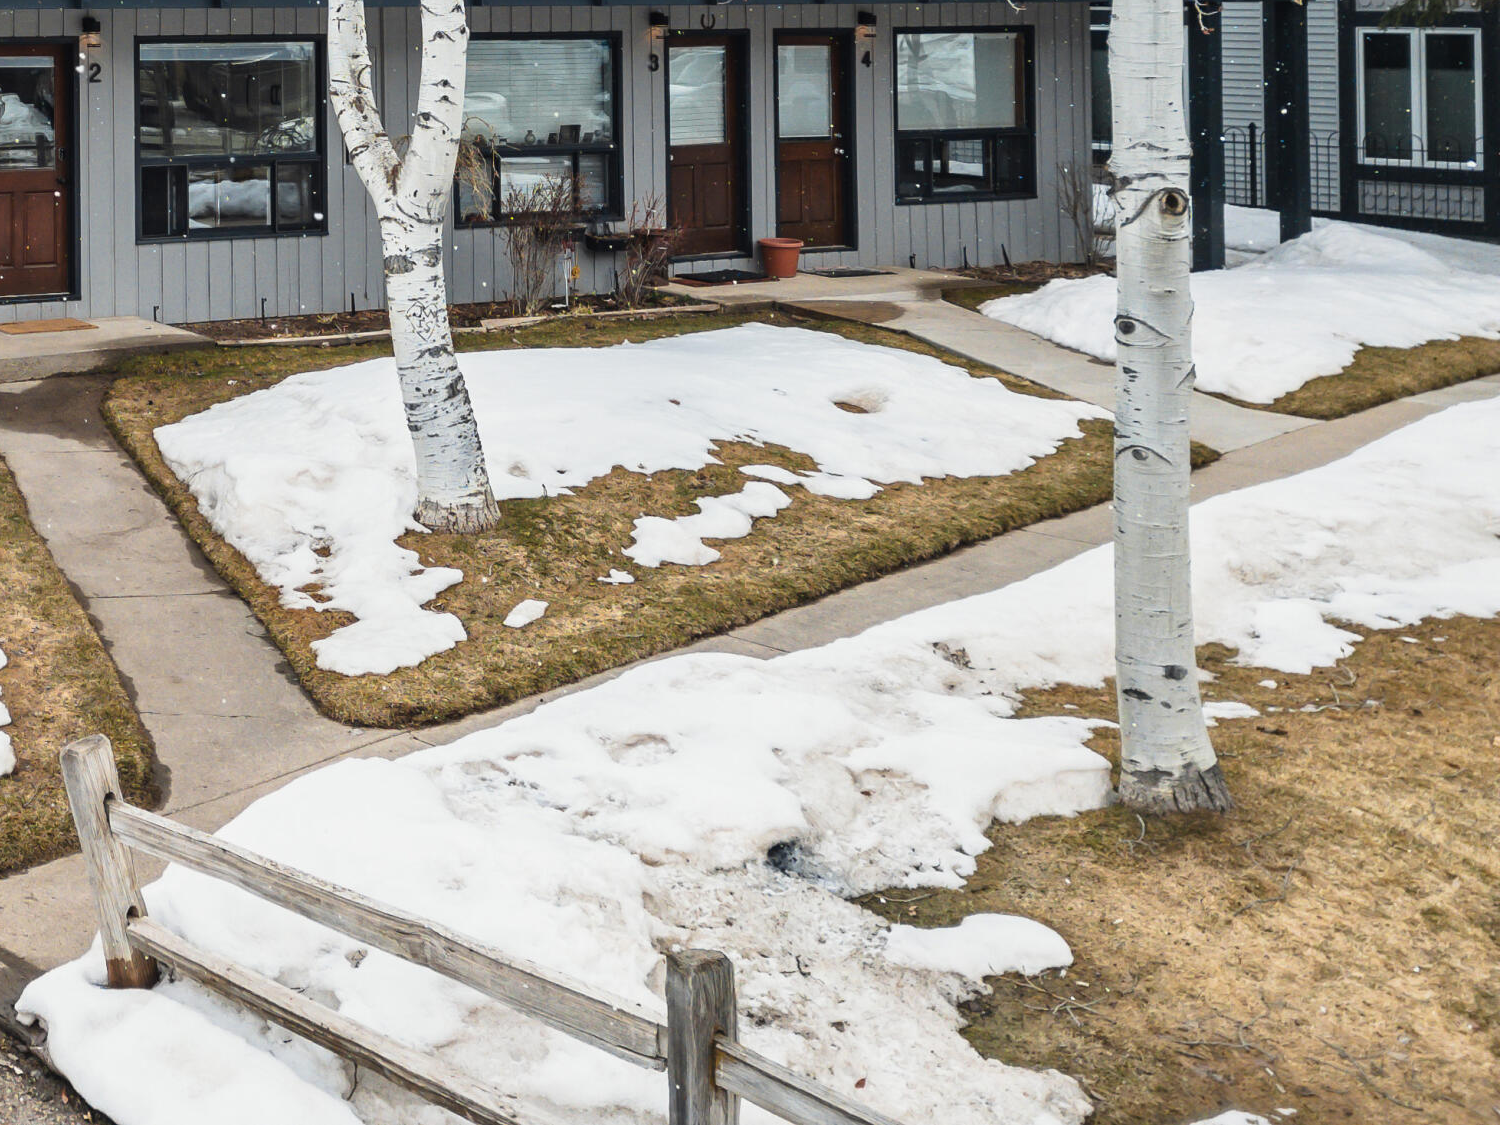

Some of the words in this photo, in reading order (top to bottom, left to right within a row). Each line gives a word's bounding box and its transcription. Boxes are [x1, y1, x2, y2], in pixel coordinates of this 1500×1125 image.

[648, 53, 660, 72] 3
[861, 50, 872, 68] 4
[88, 62, 102, 83] 2
